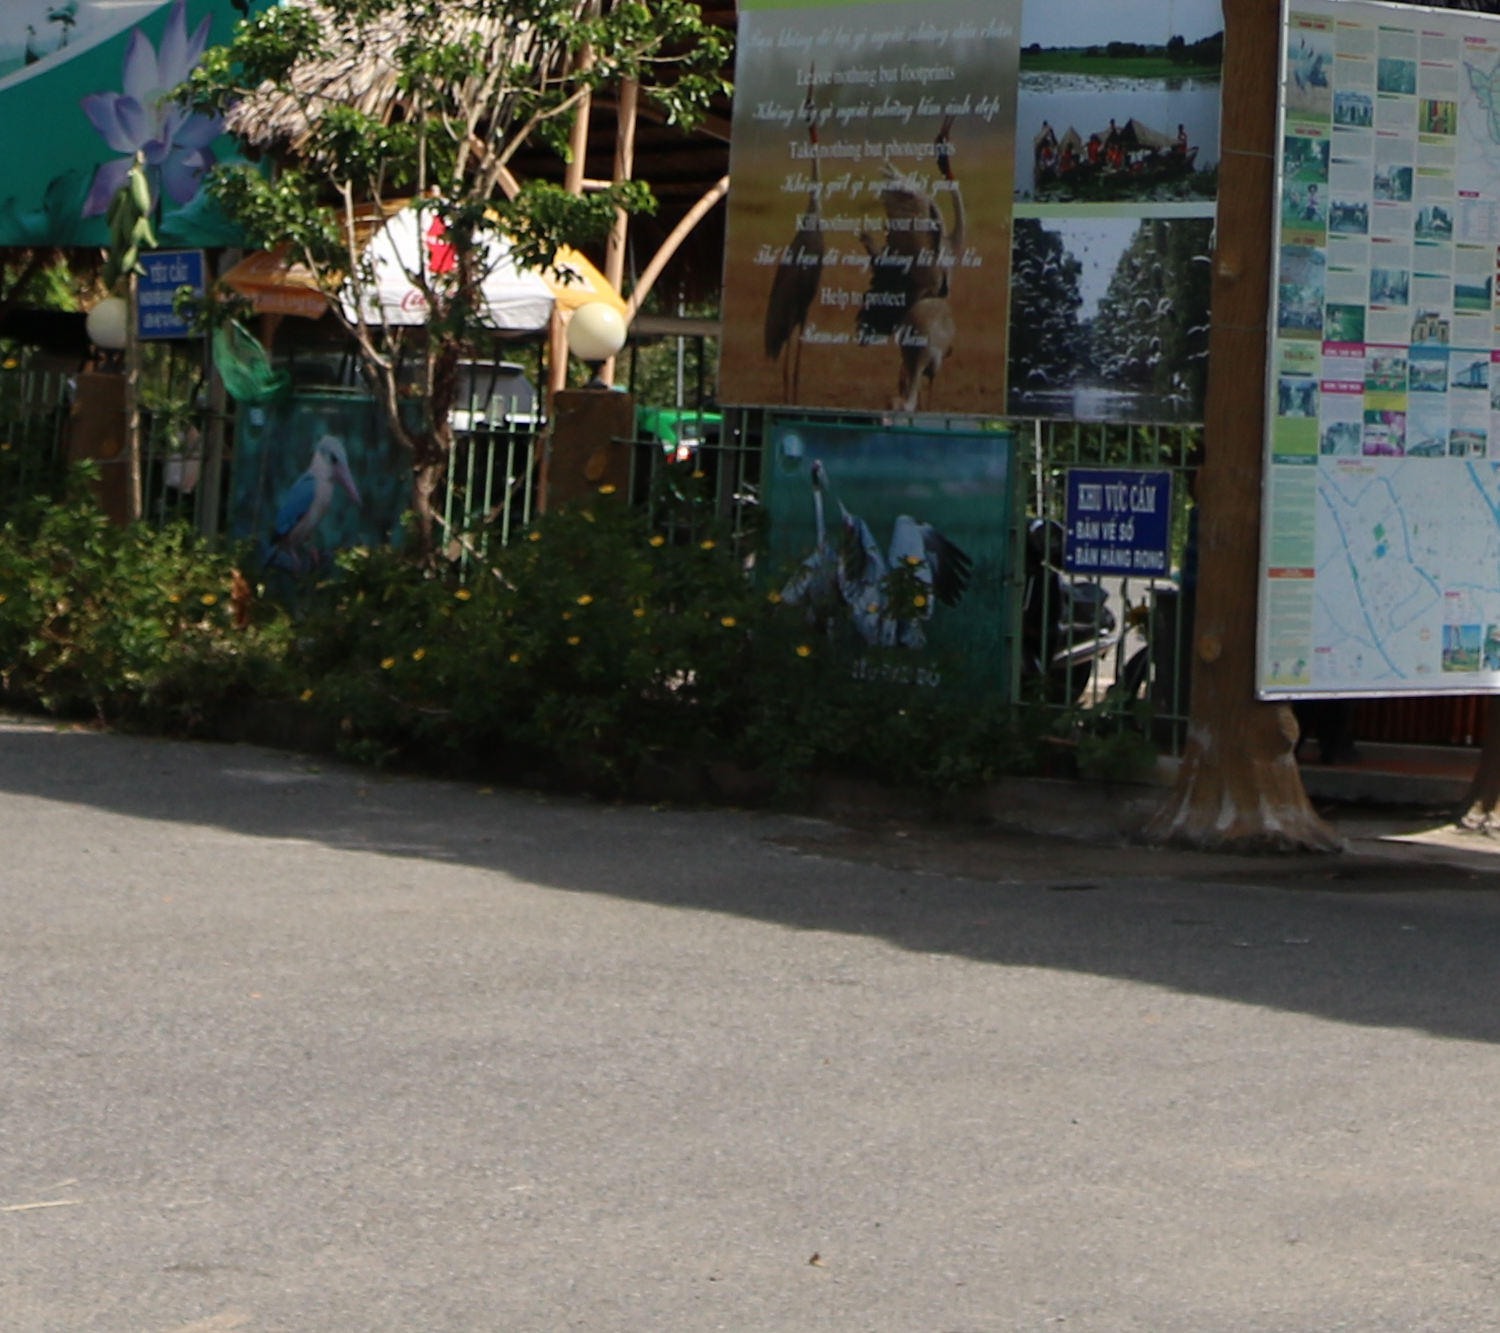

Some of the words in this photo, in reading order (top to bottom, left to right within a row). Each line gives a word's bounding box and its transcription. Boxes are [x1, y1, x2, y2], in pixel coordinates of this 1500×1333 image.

[797, 67, 832, 86] Leave
[834, 66, 876, 87] nothing
[878, 65, 897, 83] but
[900, 63, 955, 86] footprints
[789, 141, 816, 159] Take
[817, 141, 862, 162] nothing
[863, 140, 883, 159] but
[884, 139, 955, 163] photographs
[795, 215, 816, 232] Kill
[817, 215, 861, 237] nothing
[863, 214, 883, 232] but
[885, 217, 908, 237] your
[910, 215, 940, 232] time
[820, 287, 849, 308] Help
[851, 289, 862, 306] to
[864, 289, 905, 310] protect
